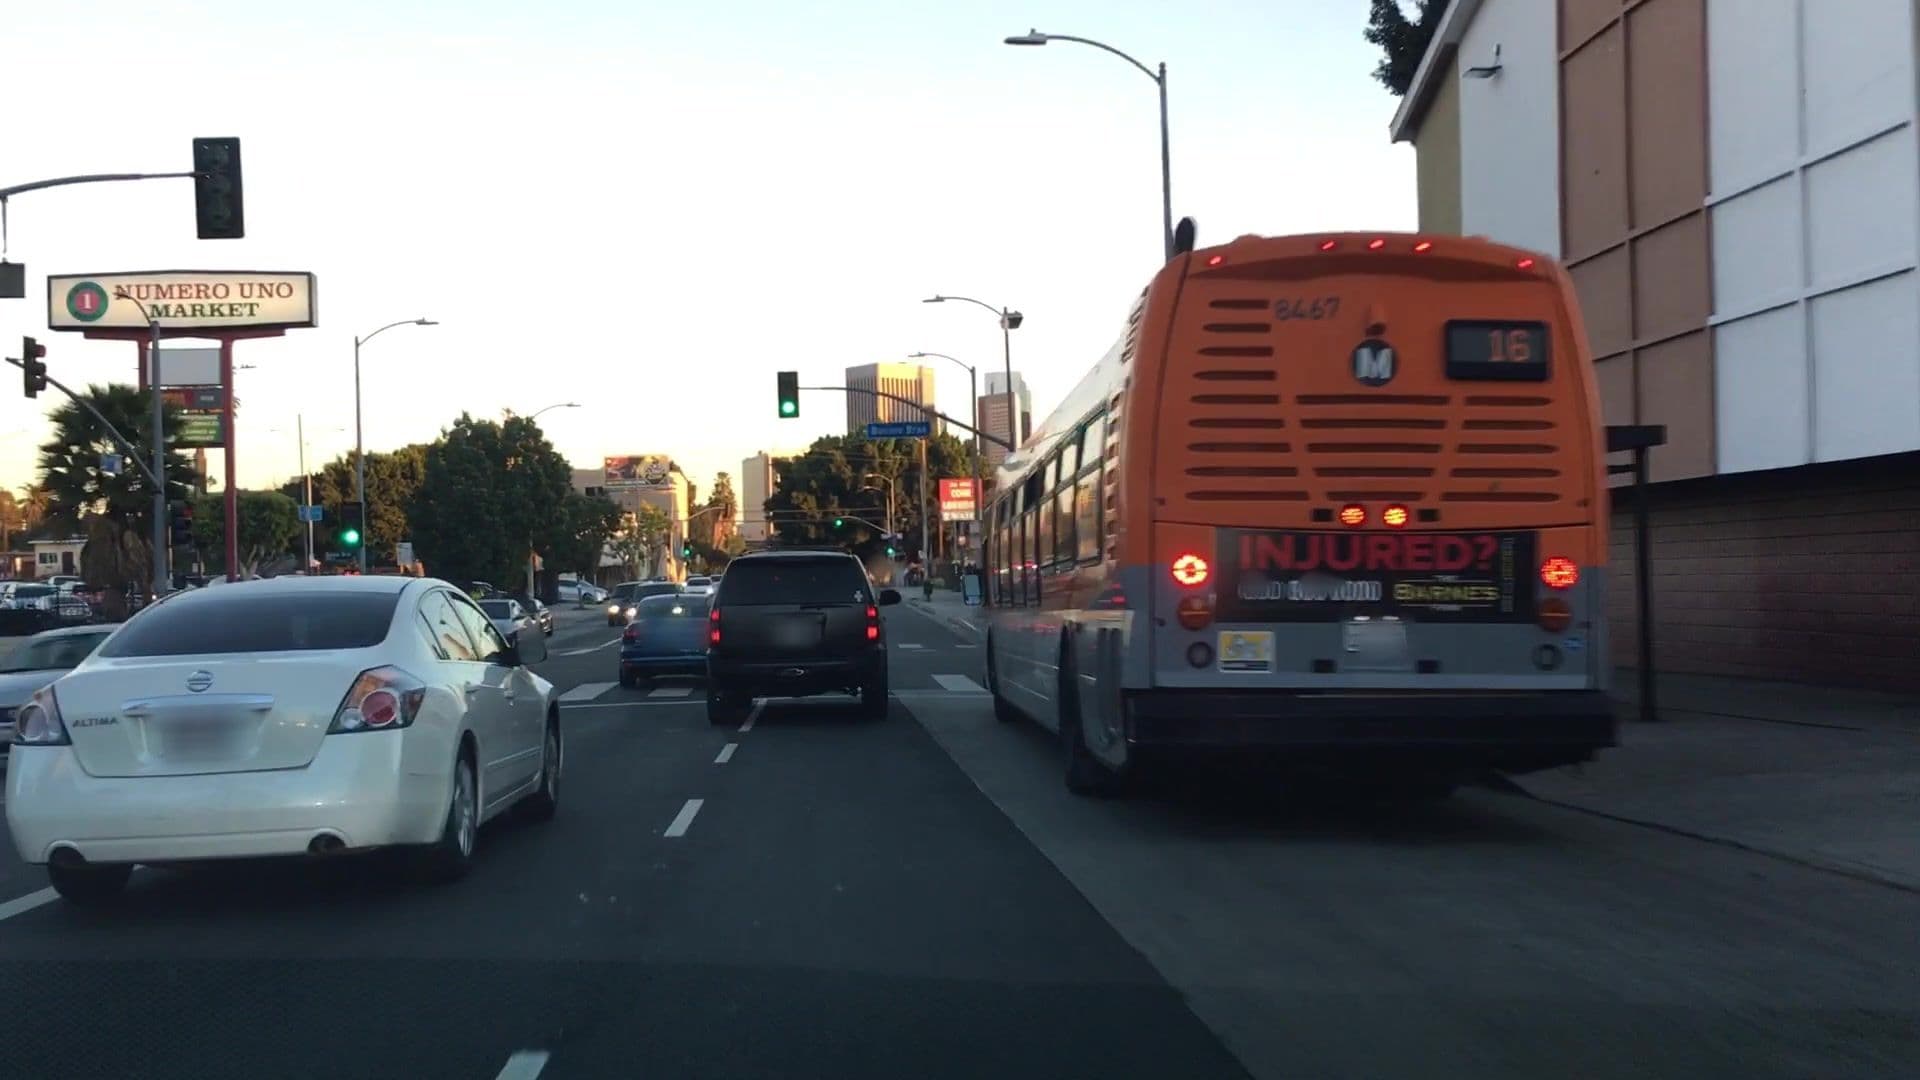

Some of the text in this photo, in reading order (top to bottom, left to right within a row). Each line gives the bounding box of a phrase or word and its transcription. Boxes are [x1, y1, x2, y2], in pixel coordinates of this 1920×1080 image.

[81, 293, 92, 309] 1
[115, 283, 230, 301] NUMERO
[239, 281, 294, 299] UNO
[150, 303, 260, 318] MARKET
[1273, 297, 1339, 321] 8467
[1488, 329, 1533, 362] 16
[1356, 347, 1393, 379] M
[1238, 534, 1499, 571] INJURED?
[72, 717, 120, 728] ALTIMA
